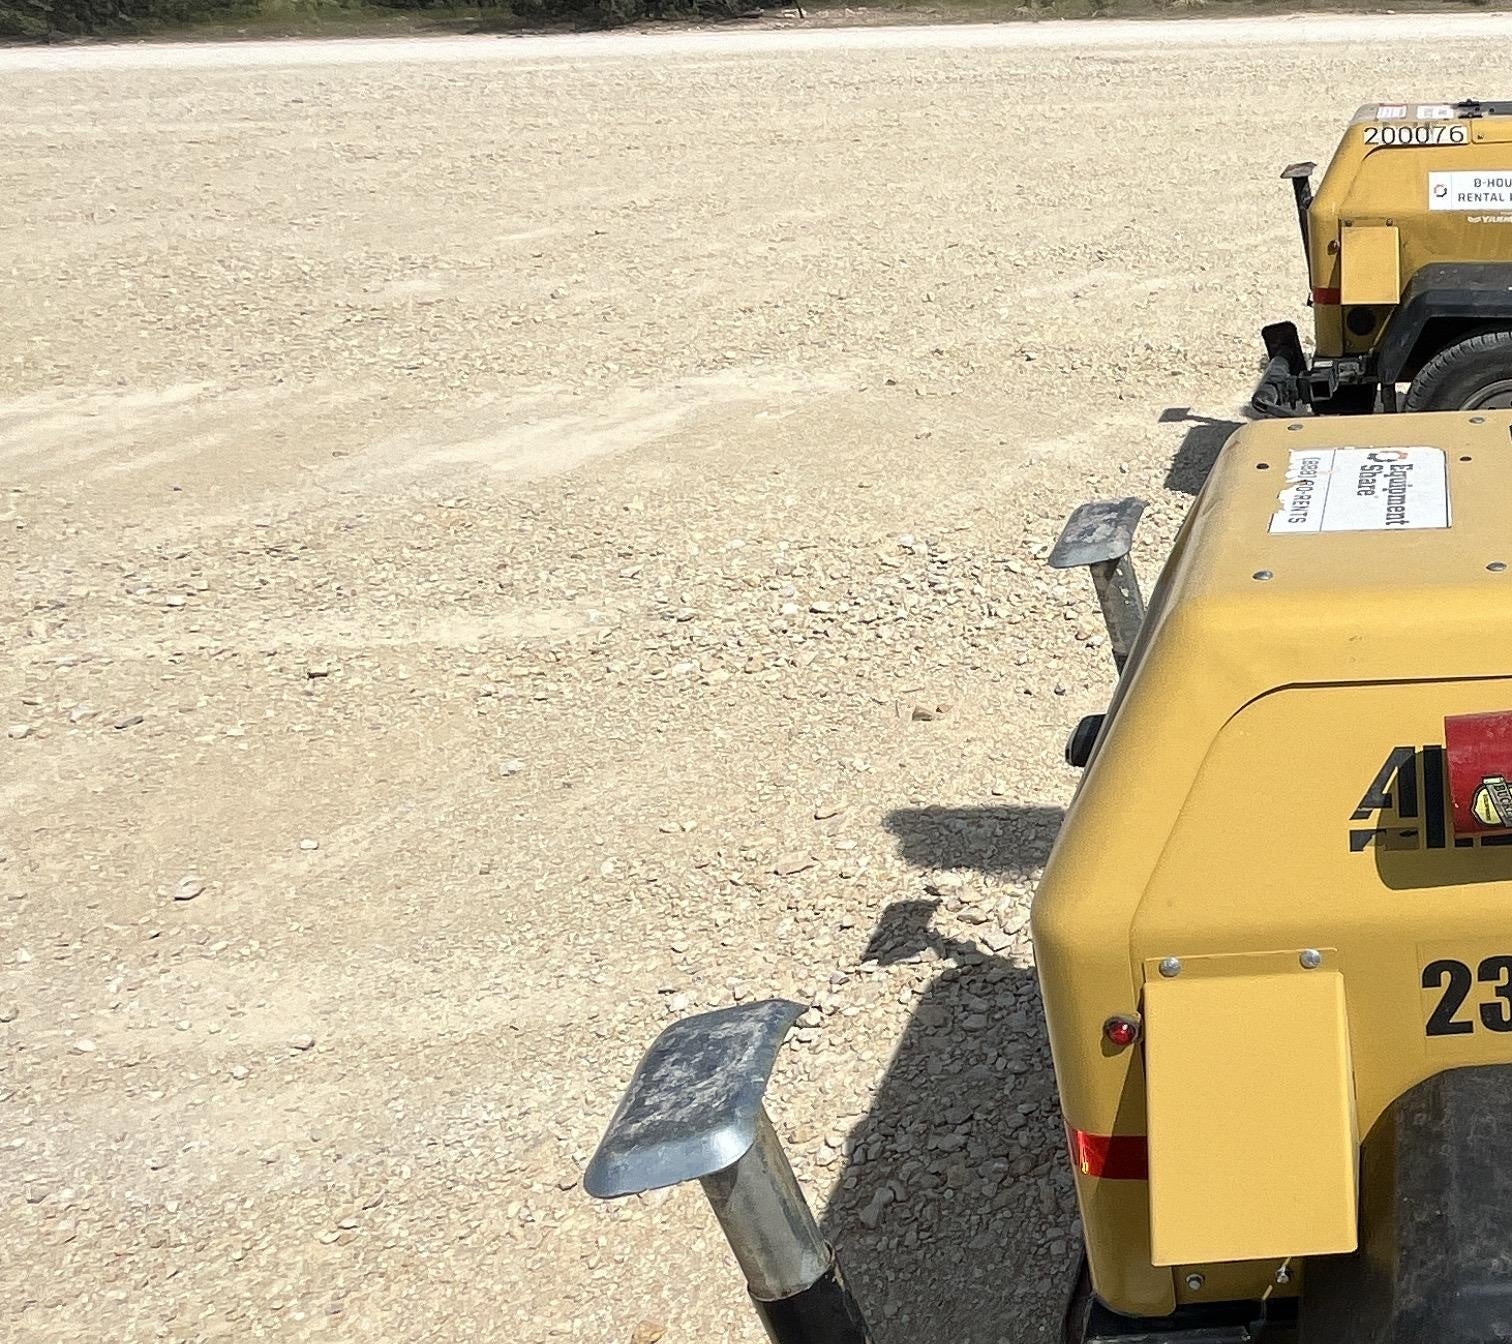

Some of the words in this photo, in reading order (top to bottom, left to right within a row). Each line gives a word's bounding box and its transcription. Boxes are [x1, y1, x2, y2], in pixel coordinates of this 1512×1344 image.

[1364, 125, 1465, 145] 200076
[1458, 192, 1505, 202] RENTAL
[1356, 464, 1384, 497] Share
[1383, 463, 1414, 526] Equipment
